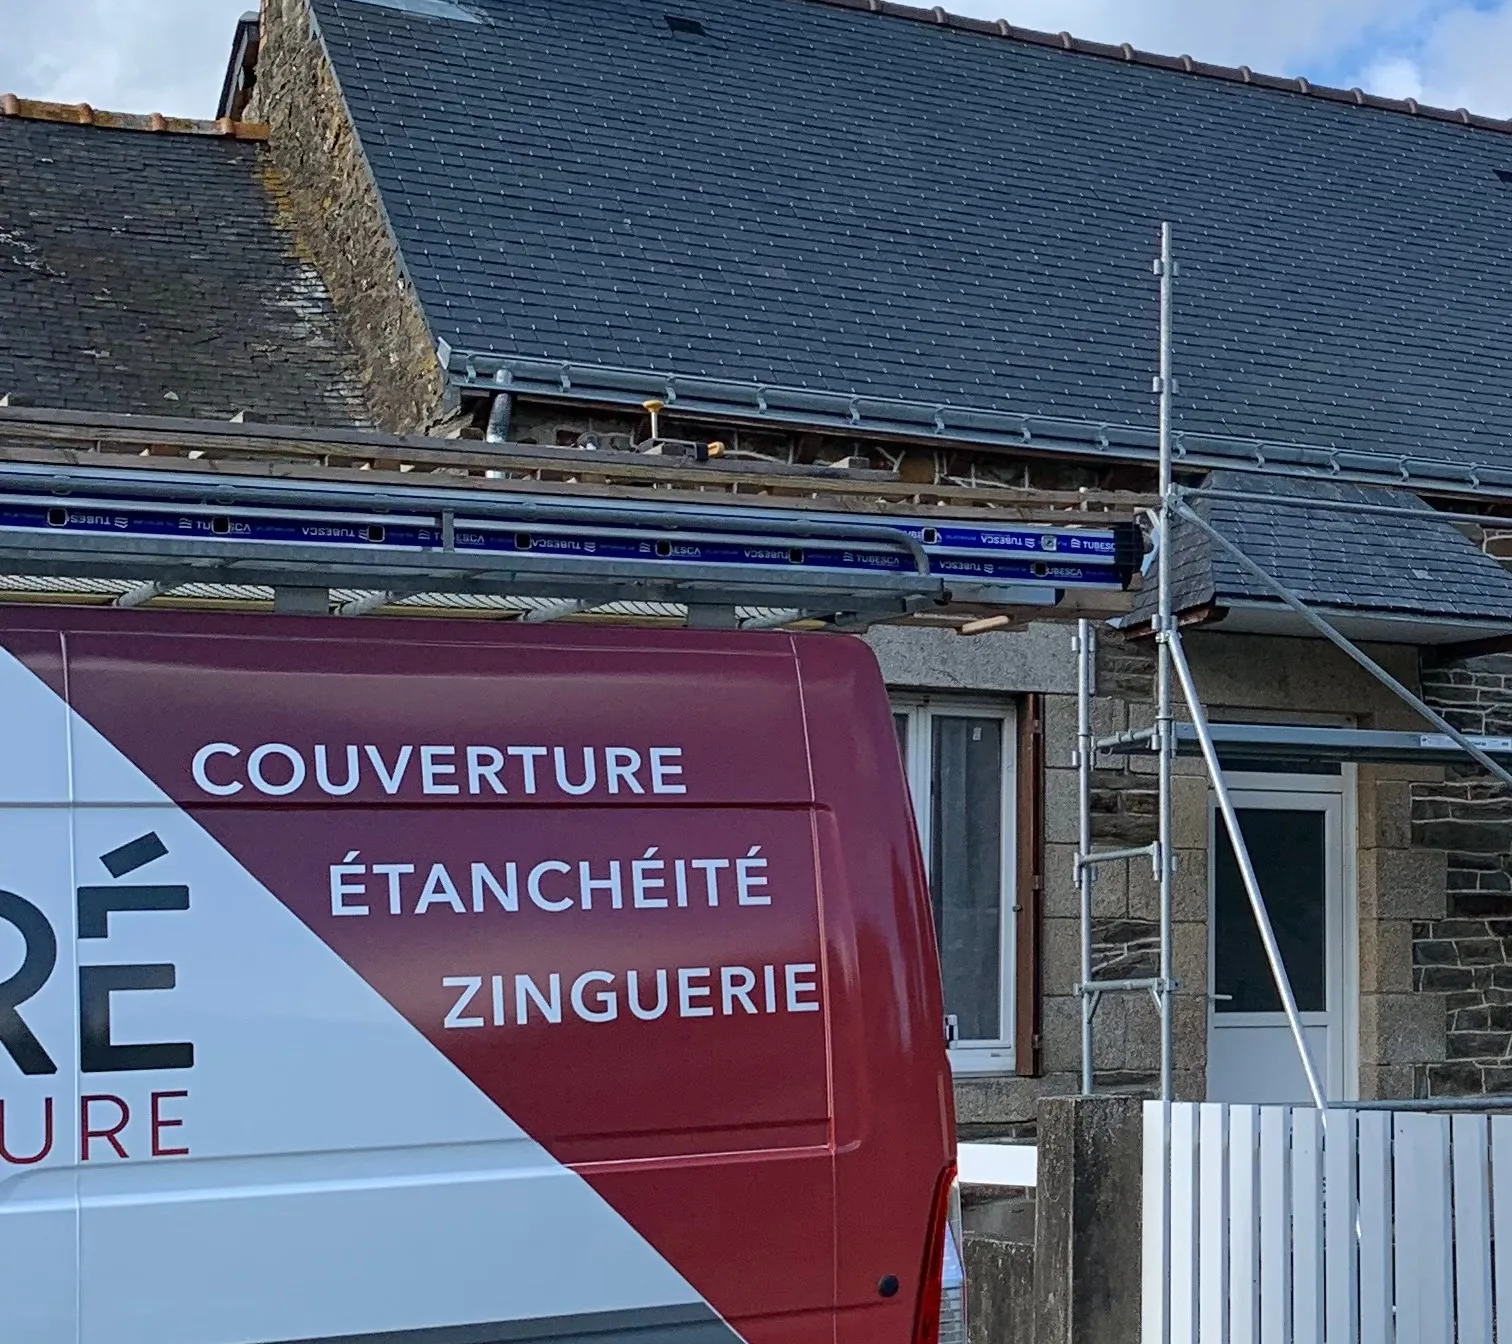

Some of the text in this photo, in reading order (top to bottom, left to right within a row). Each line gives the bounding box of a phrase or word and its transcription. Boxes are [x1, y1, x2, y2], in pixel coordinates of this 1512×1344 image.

[70, 514, 111, 525] TUBES
[196, 520, 251, 532] TUSCA
[302, 527, 355, 538] TUBESCA
[434, 532, 485, 543] TESCA
[532, 539, 581, 550] TUBESCA
[981, 534, 1023, 545] TUBESCA
[1083, 540, 1115, 550] TUBESC
[744, 549, 790, 559] TUBESCA
[857, 554, 900, 564] TUBESCA
[939, 560, 982, 571] TUBESCA
[1047, 567, 1083, 577] UBESCA
[190, 741, 688, 796] COUVERTURE
[329, 845, 772, 917] ÉTANCHÉITÉ
[442, 963, 821, 1029] ZINGUERIE
[0, 1089, 189, 1165] URE
